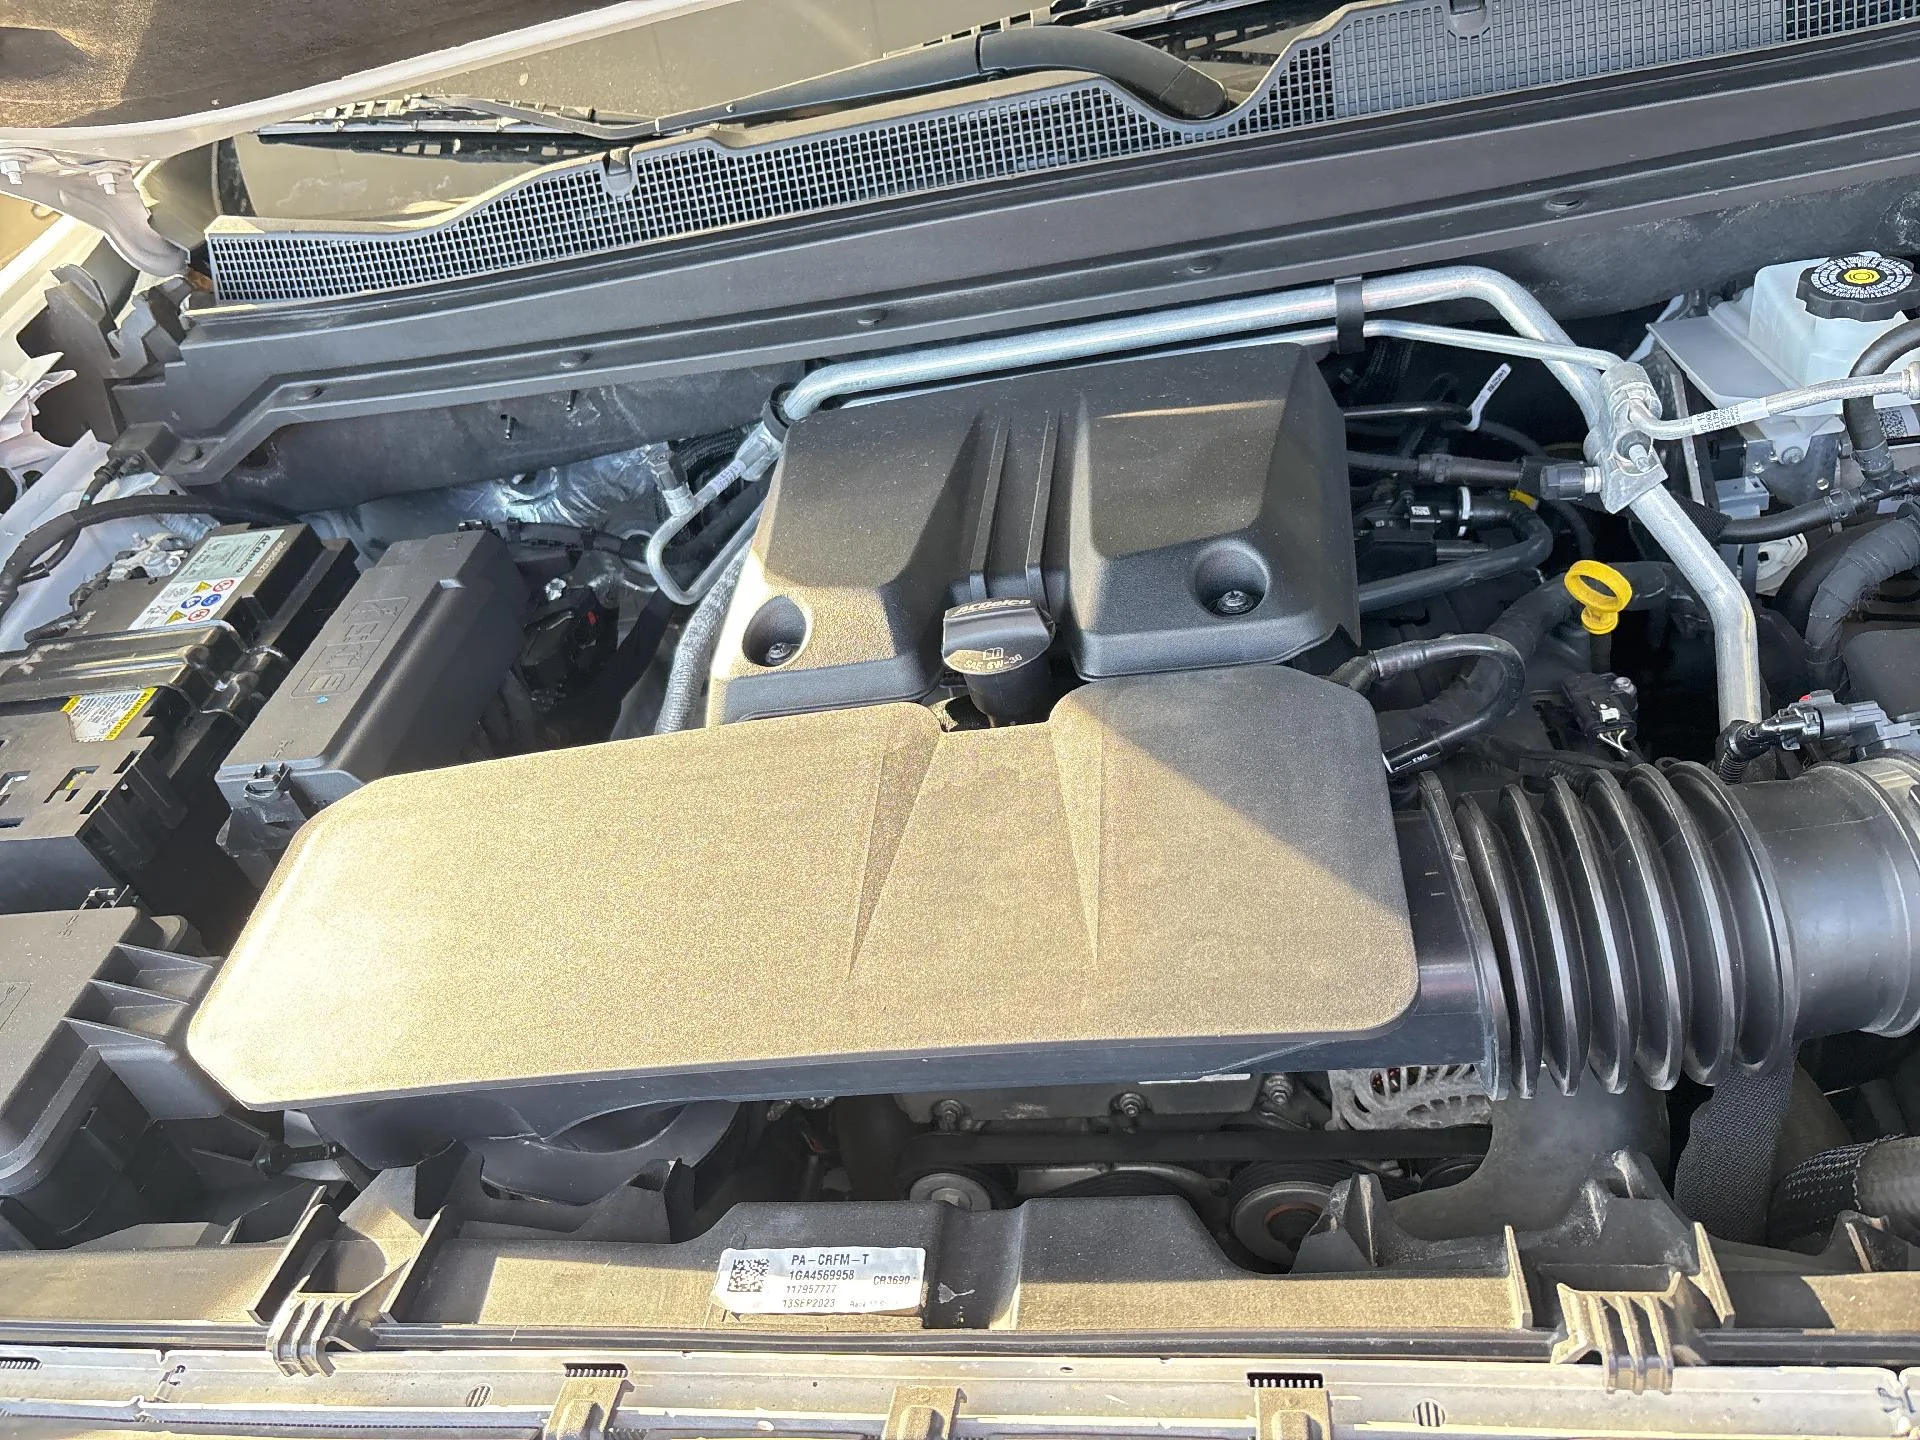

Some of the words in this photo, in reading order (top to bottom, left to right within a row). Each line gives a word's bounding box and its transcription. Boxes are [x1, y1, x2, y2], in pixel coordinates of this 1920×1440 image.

[236, 535, 271, 573] ACDelco
[955, 599, 1031, 615] ACDelco
[963, 660, 982, 670] SAE
[791, 1253, 870, 1266] PA-CRFM-T
[789, 1269, 856, 1281] 1GA4569958
[873, 1275, 911, 1286] CR3690
[786, 1284, 837, 1294] 117957777
[782, 1298, 836, 1309] 13SEP2023
